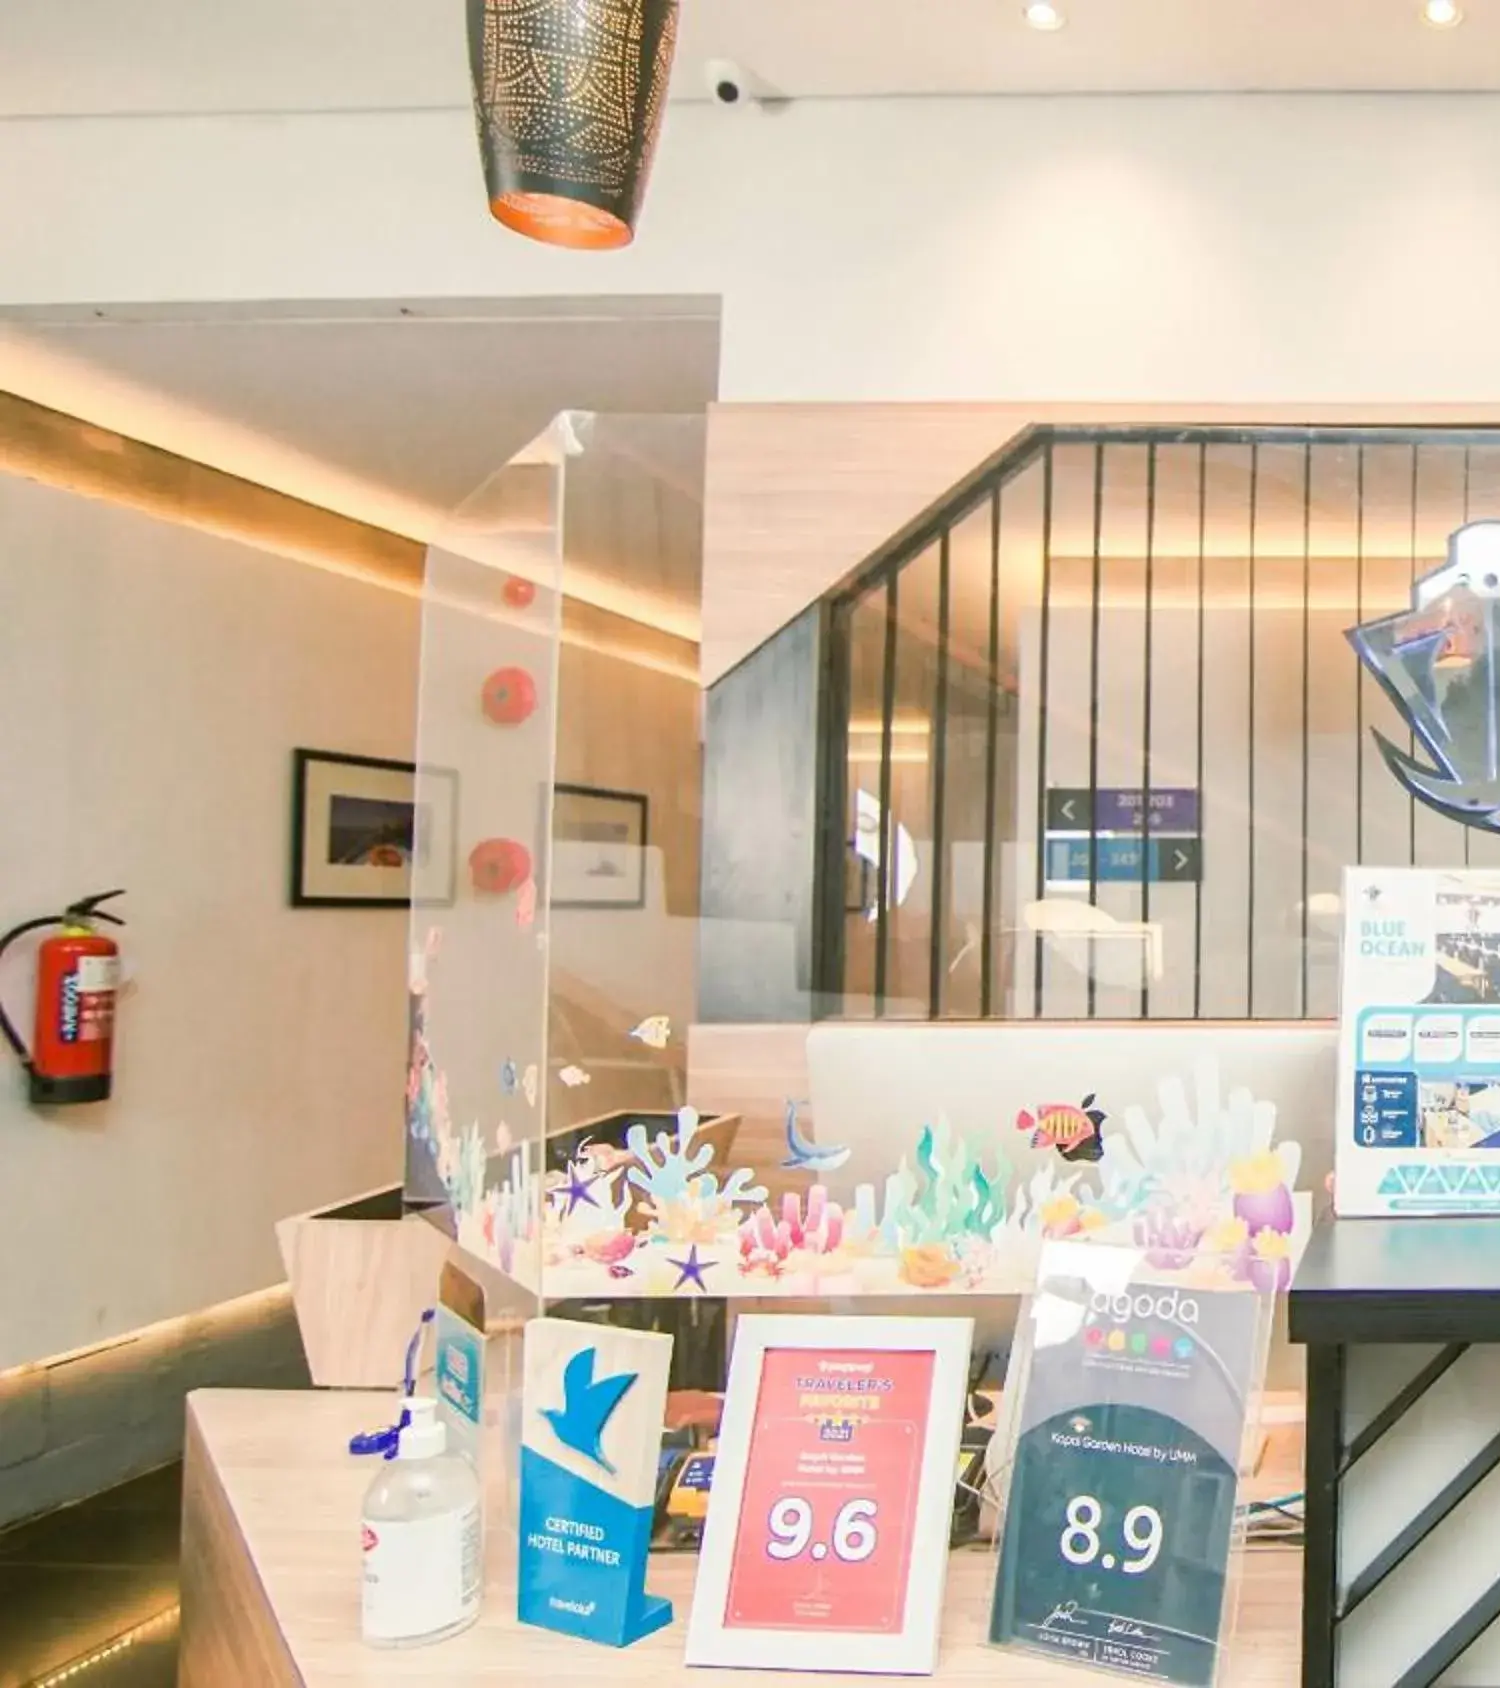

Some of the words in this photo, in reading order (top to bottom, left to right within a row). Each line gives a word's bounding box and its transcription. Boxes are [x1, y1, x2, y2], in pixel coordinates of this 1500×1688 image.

[1360, 920, 1406, 937] BLUE
[1360, 939, 1426, 957] OCEAN
[1090, 1289, 1199, 1324] agoda
[796, 1377, 893, 1392] TRAVELER'S
[1083, 1436, 1122, 1453] Garden
[1153, 1446, 1167, 1463] by
[544, 1516, 605, 1542] CERTIFIED
[765, 1496, 879, 1562] 9.6
[1058, 1493, 1164, 1575] 8.9
[527, 1531, 564, 1554] HOTEL
[567, 1540, 621, 1568] PARTNER
